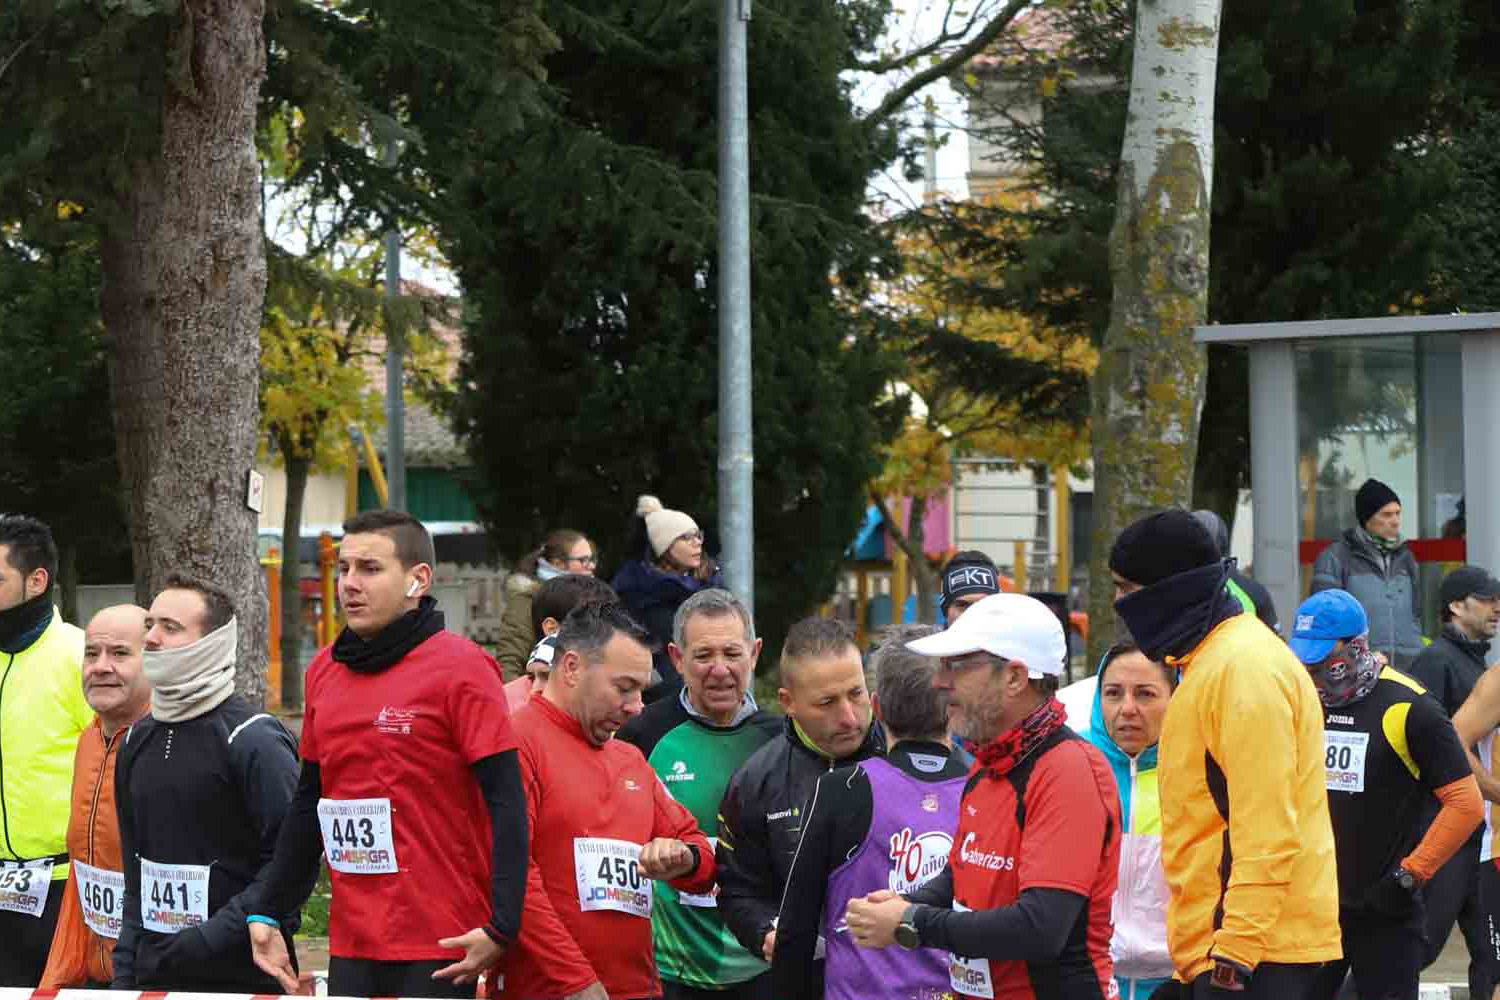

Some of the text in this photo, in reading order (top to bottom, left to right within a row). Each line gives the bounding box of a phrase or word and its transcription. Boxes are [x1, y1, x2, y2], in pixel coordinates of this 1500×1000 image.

[1325, 745, 1351, 770] 80
[332, 818, 375, 848] 443
[961, 831, 1014, 871] Cabrerizos
[597, 857, 641, 890] 450
[84, 881, 115, 915] 460
[151, 880, 189, 911] 441
